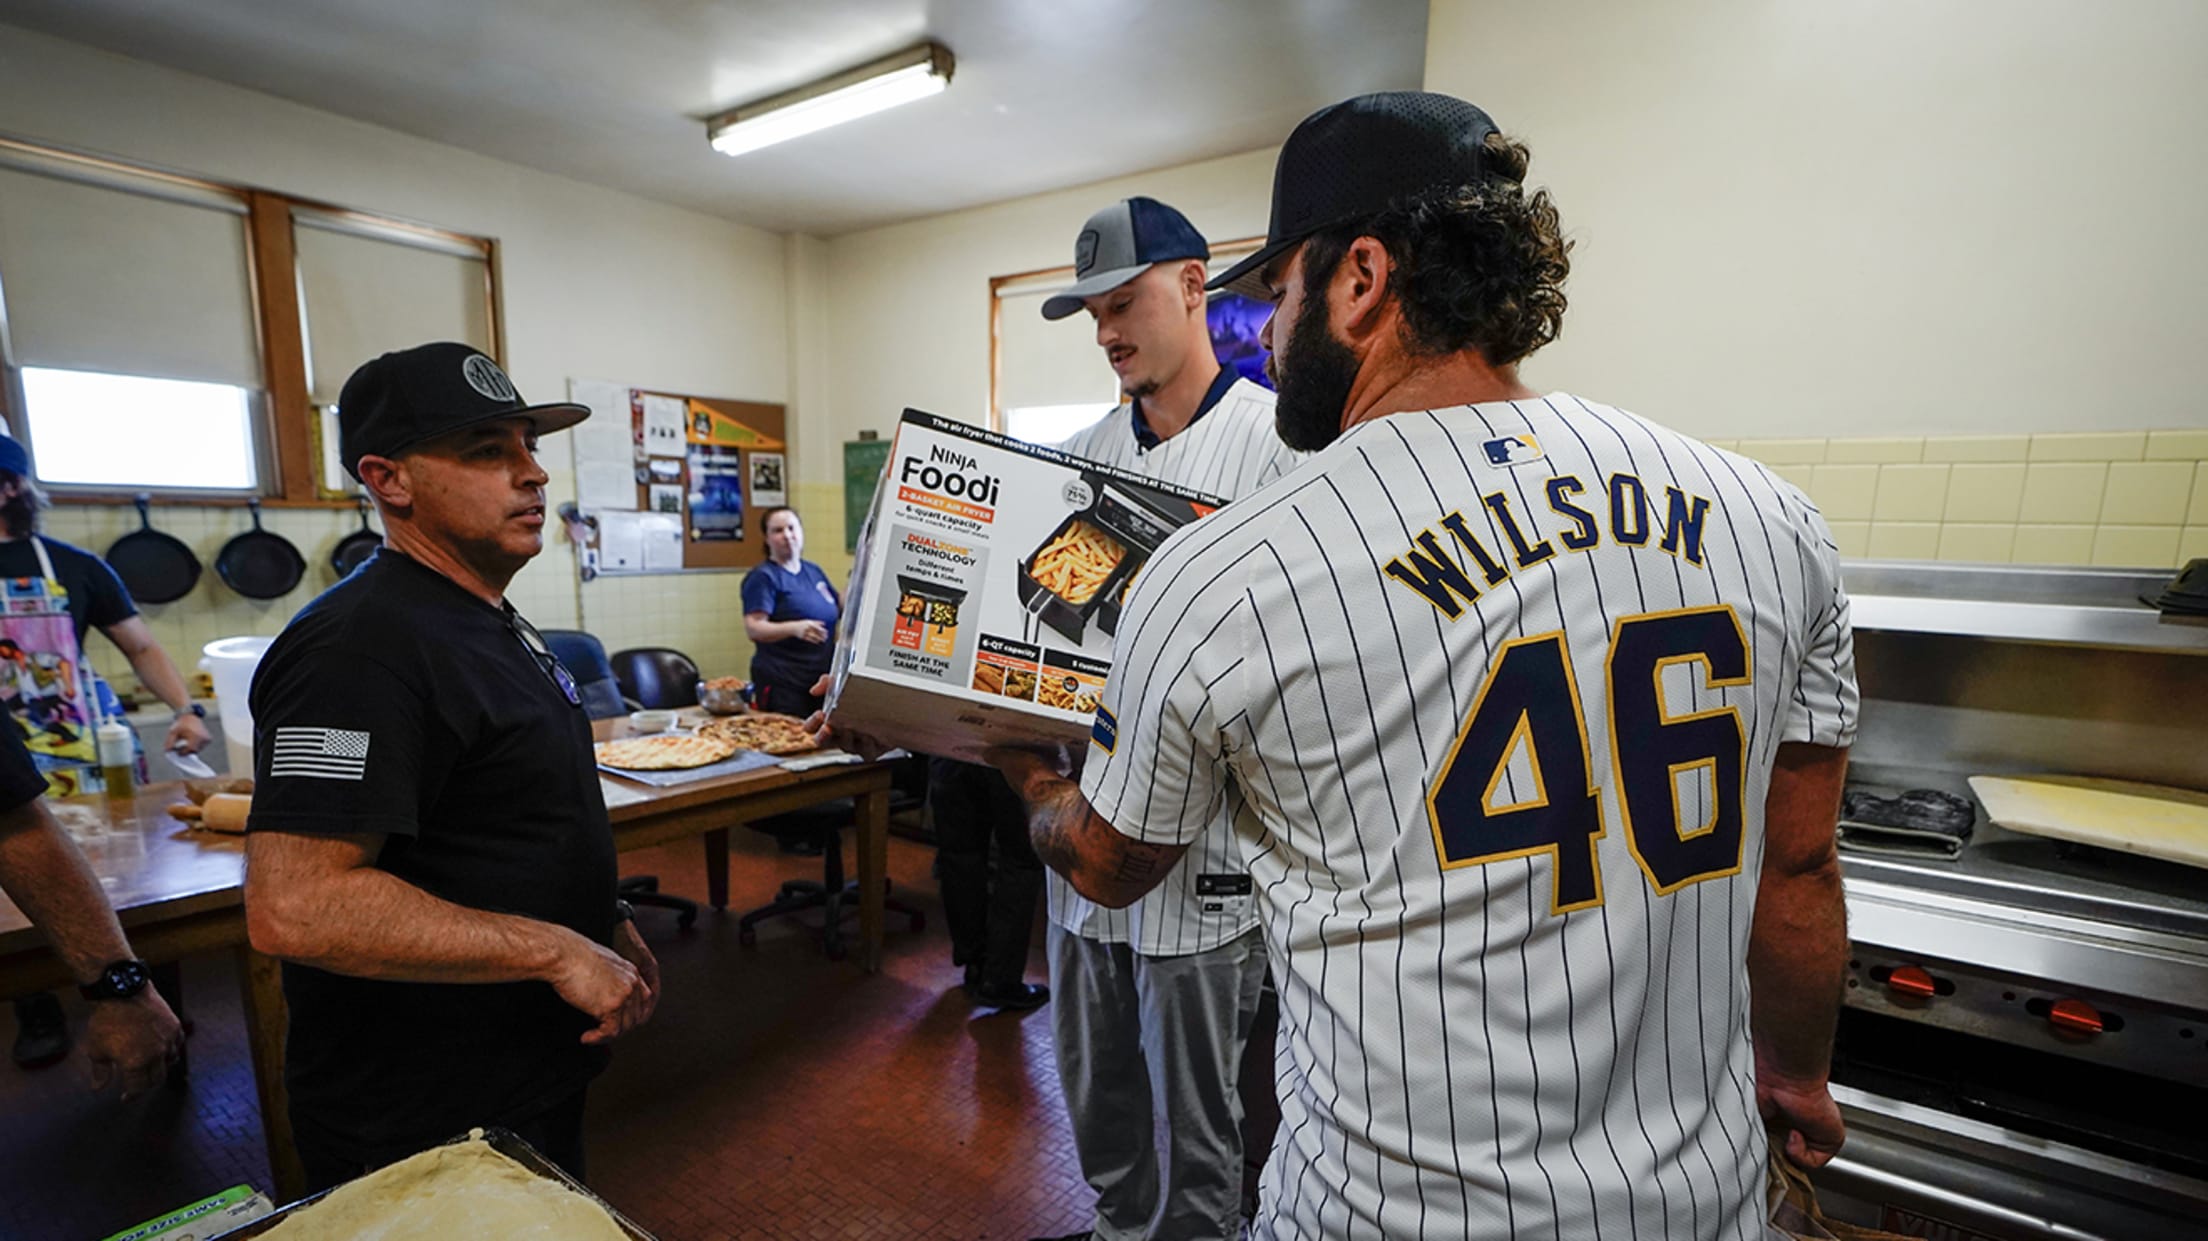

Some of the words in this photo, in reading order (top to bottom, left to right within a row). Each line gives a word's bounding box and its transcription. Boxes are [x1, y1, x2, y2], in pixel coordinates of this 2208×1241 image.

[930, 444, 978, 472] NINJA
[932, 418, 949, 429] The
[950, 423, 962, 432] air
[963, 426, 984, 440] fryer
[985, 433, 1003, 444] that
[1004, 440, 1029, 452] cooks
[1095, 465, 1111, 474] and
[1112, 469, 1147, 485] FINISHES
[1147, 480, 1159, 488] AT
[1160, 483, 1175, 493] THE
[1176, 487, 1198, 500] SAME
[901, 456, 1001, 506] Foodi
[901, 490, 945, 507] 2-BASKET
[946, 502, 962, 512] AIR
[963, 507, 991, 519] FRYER
[906, 505, 941, 520] 6-quart
[942, 514, 982, 531] capacity
[901, 540, 976, 567] TECHNOLOGY
[1384, 472, 1711, 622] WILSON
[906, 565, 932, 577] temps
[941, 572, 964, 584] times
[918, 559, 955, 573] Different
[889, 650, 919, 661] FINISH
[920, 656, 931, 664] AT
[932, 659, 950, 669] THE
[982, 638, 1003, 650] 6-QT
[1004, 645, 1037, 659] capacity
[893, 660, 918, 672] SAME
[920, 665, 944, 677] TIME
[1426, 604, 1751, 917] 46
[184, 1197, 226, 1218] SAME
[150, 1216, 181, 1232] SIZE
